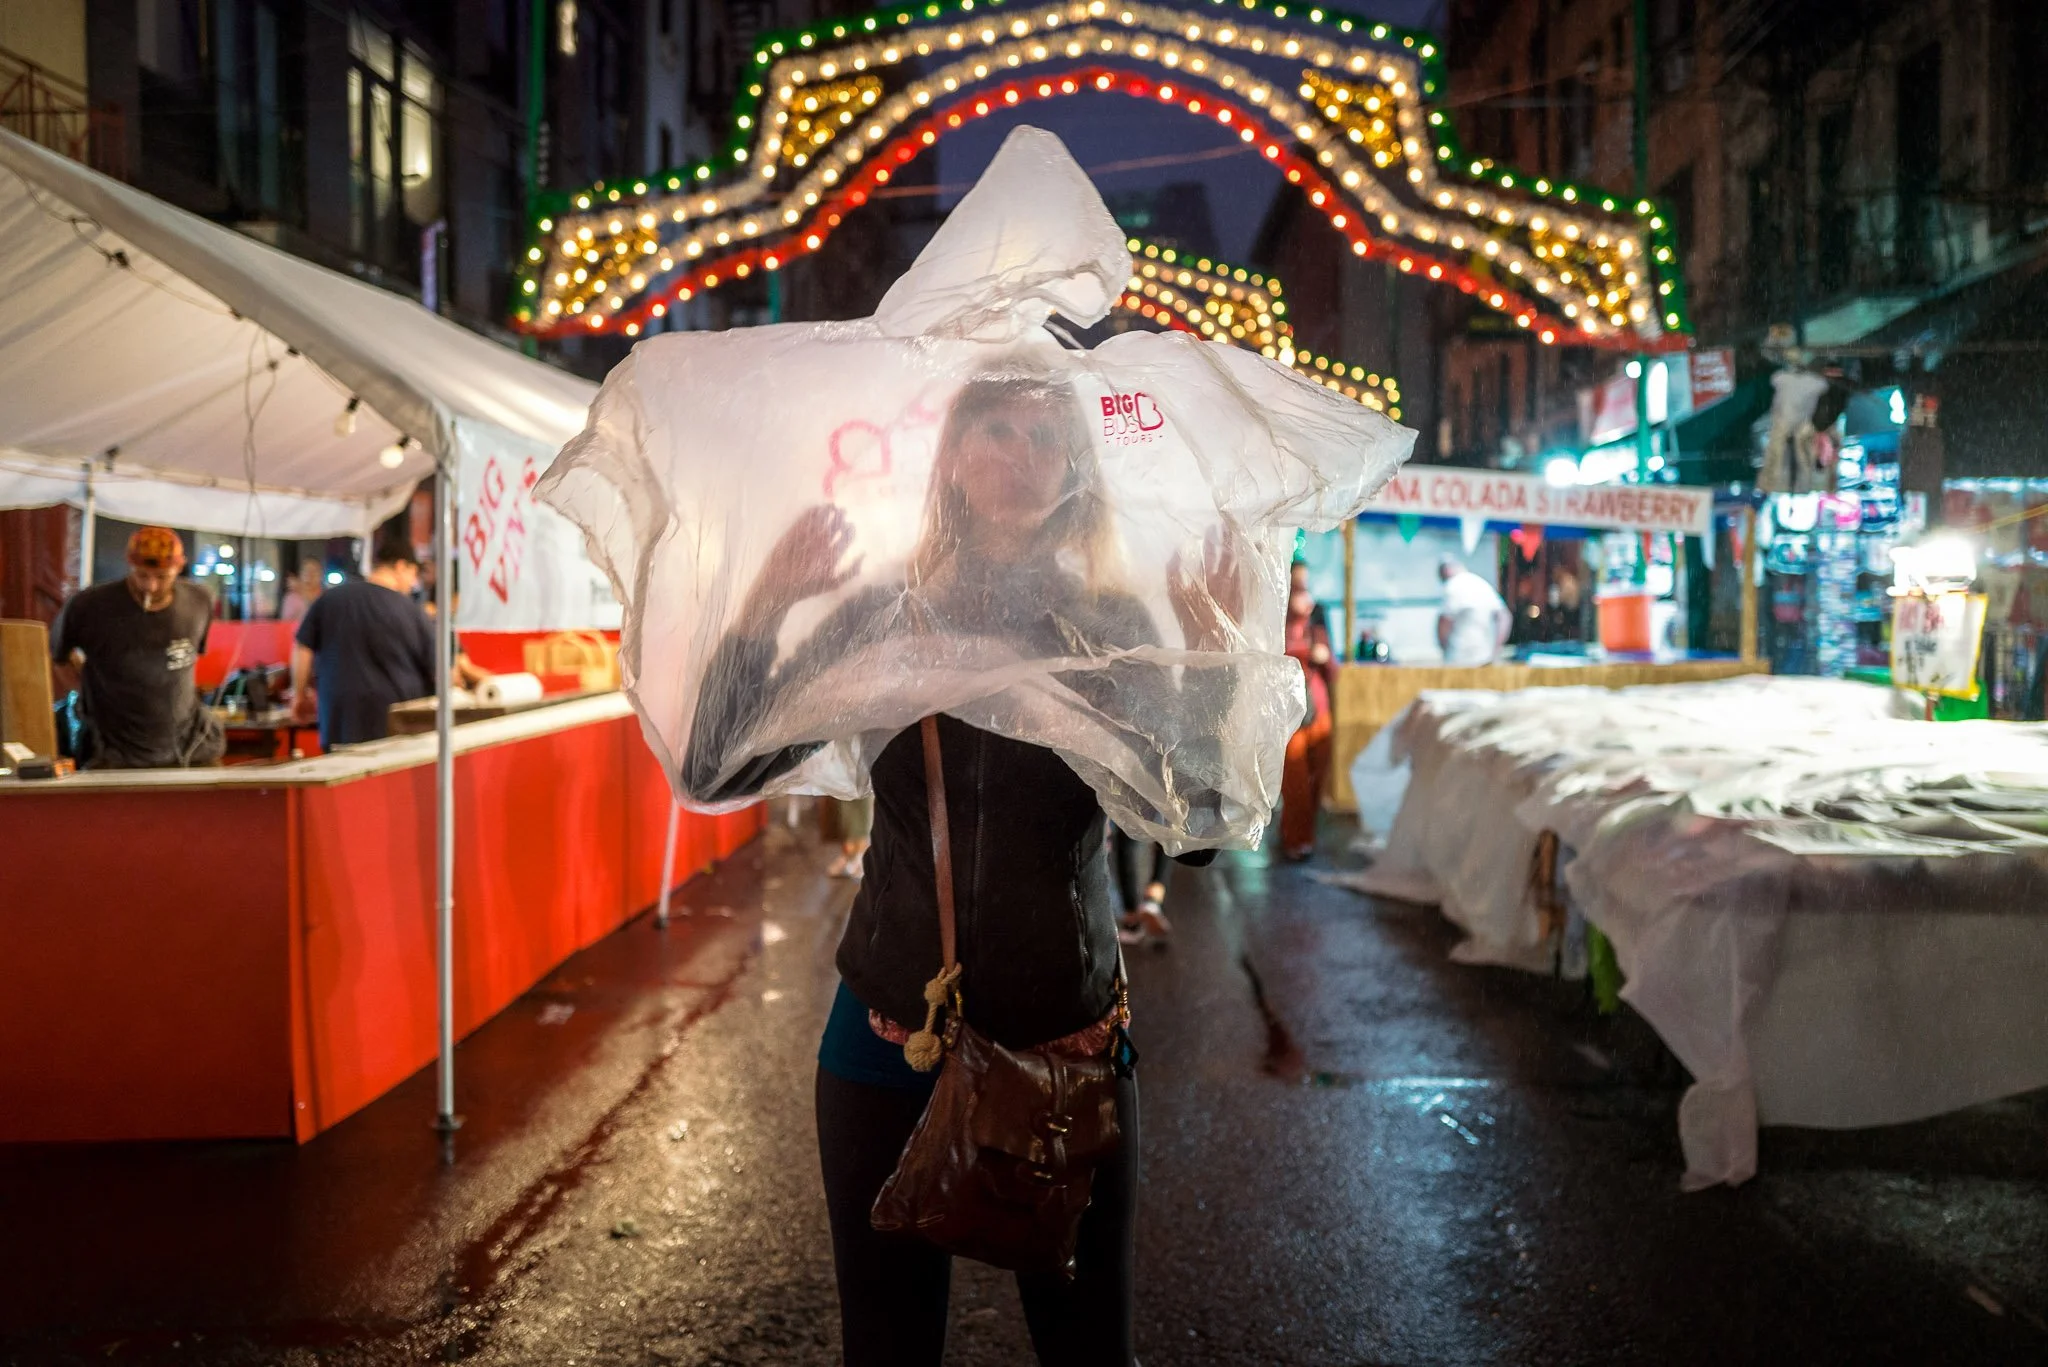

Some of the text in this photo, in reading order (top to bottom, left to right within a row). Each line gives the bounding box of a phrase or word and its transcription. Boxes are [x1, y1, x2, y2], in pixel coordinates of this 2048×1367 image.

[1100, 394, 1133, 416] BIG
[1103, 416, 1138, 437] BUS
[464, 455, 504, 576] BIG
[1430, 475, 1528, 512] COLADA
[1535, 486, 1700, 525] STRAWBERRY
